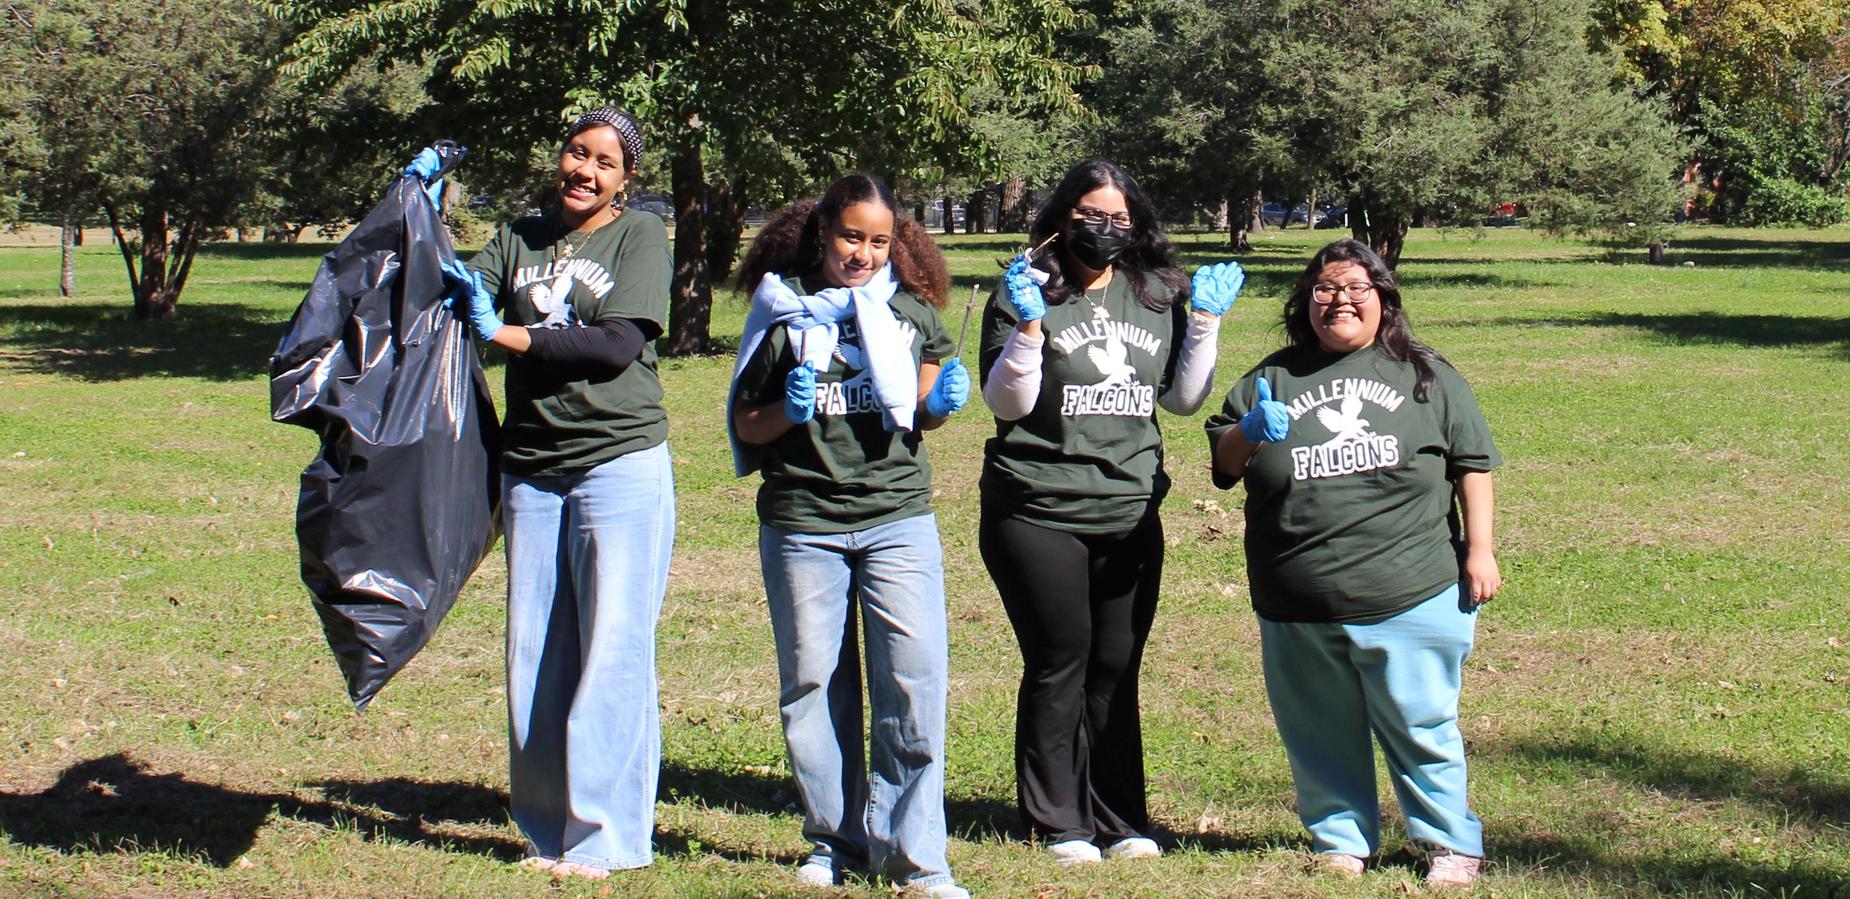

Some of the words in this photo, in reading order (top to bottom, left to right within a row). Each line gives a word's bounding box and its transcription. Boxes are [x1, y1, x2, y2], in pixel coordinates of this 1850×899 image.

[513, 257, 615, 300] MILLENNIUM
[1053, 319, 1162, 357] MILLENNIUM
[815, 382, 884, 415] FALC
[1061, 384, 1154, 417] FALCONS
[1286, 378, 1405, 421] MILLENNIUM
[1291, 434, 1400, 480] FALCONS
